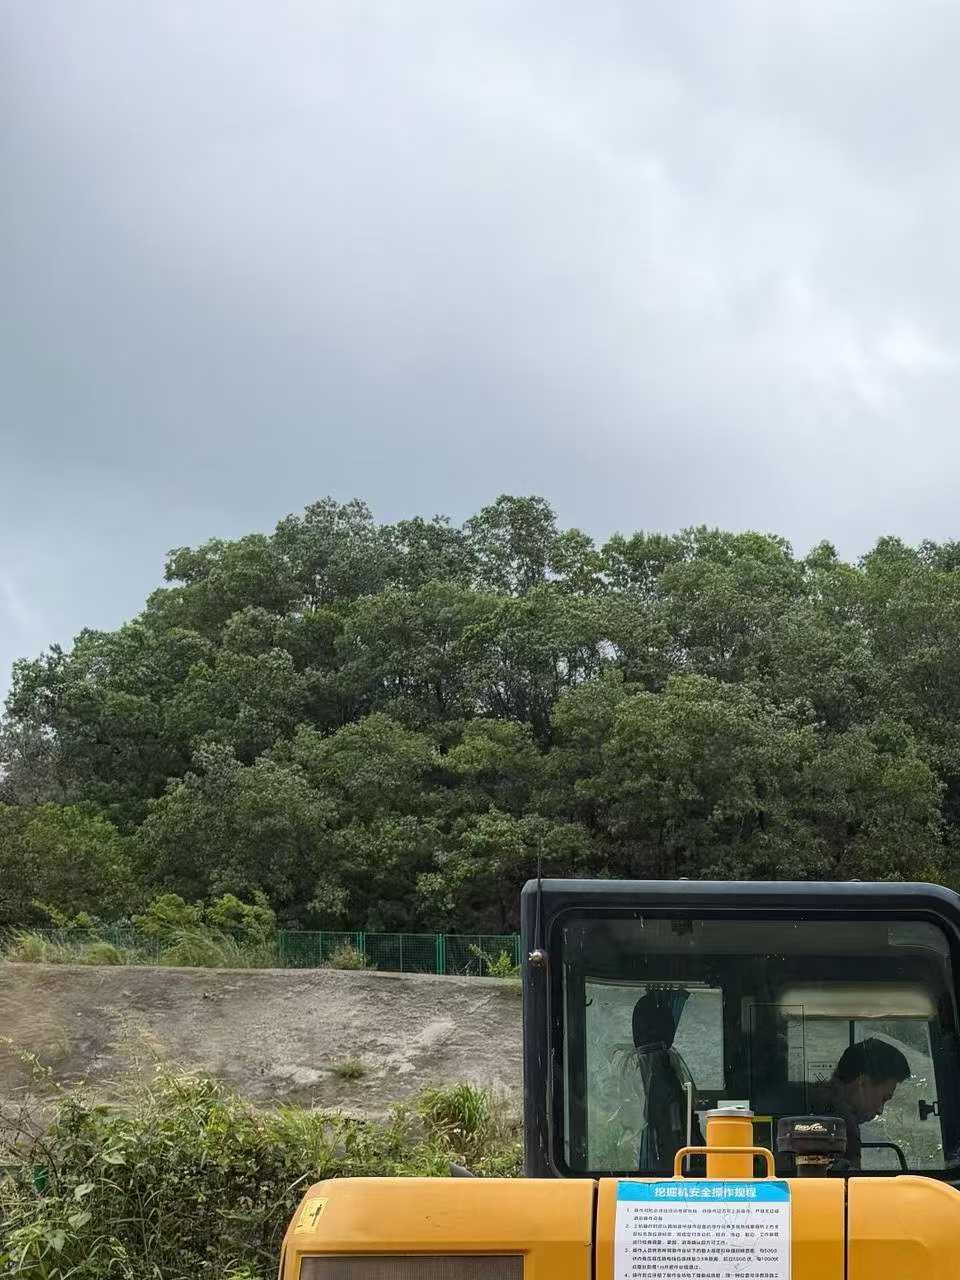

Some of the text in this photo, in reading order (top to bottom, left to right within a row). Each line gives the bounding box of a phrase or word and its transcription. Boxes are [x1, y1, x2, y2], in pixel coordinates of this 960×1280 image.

[654, 1187, 757, 1198] 挖掘机安全操作规程
